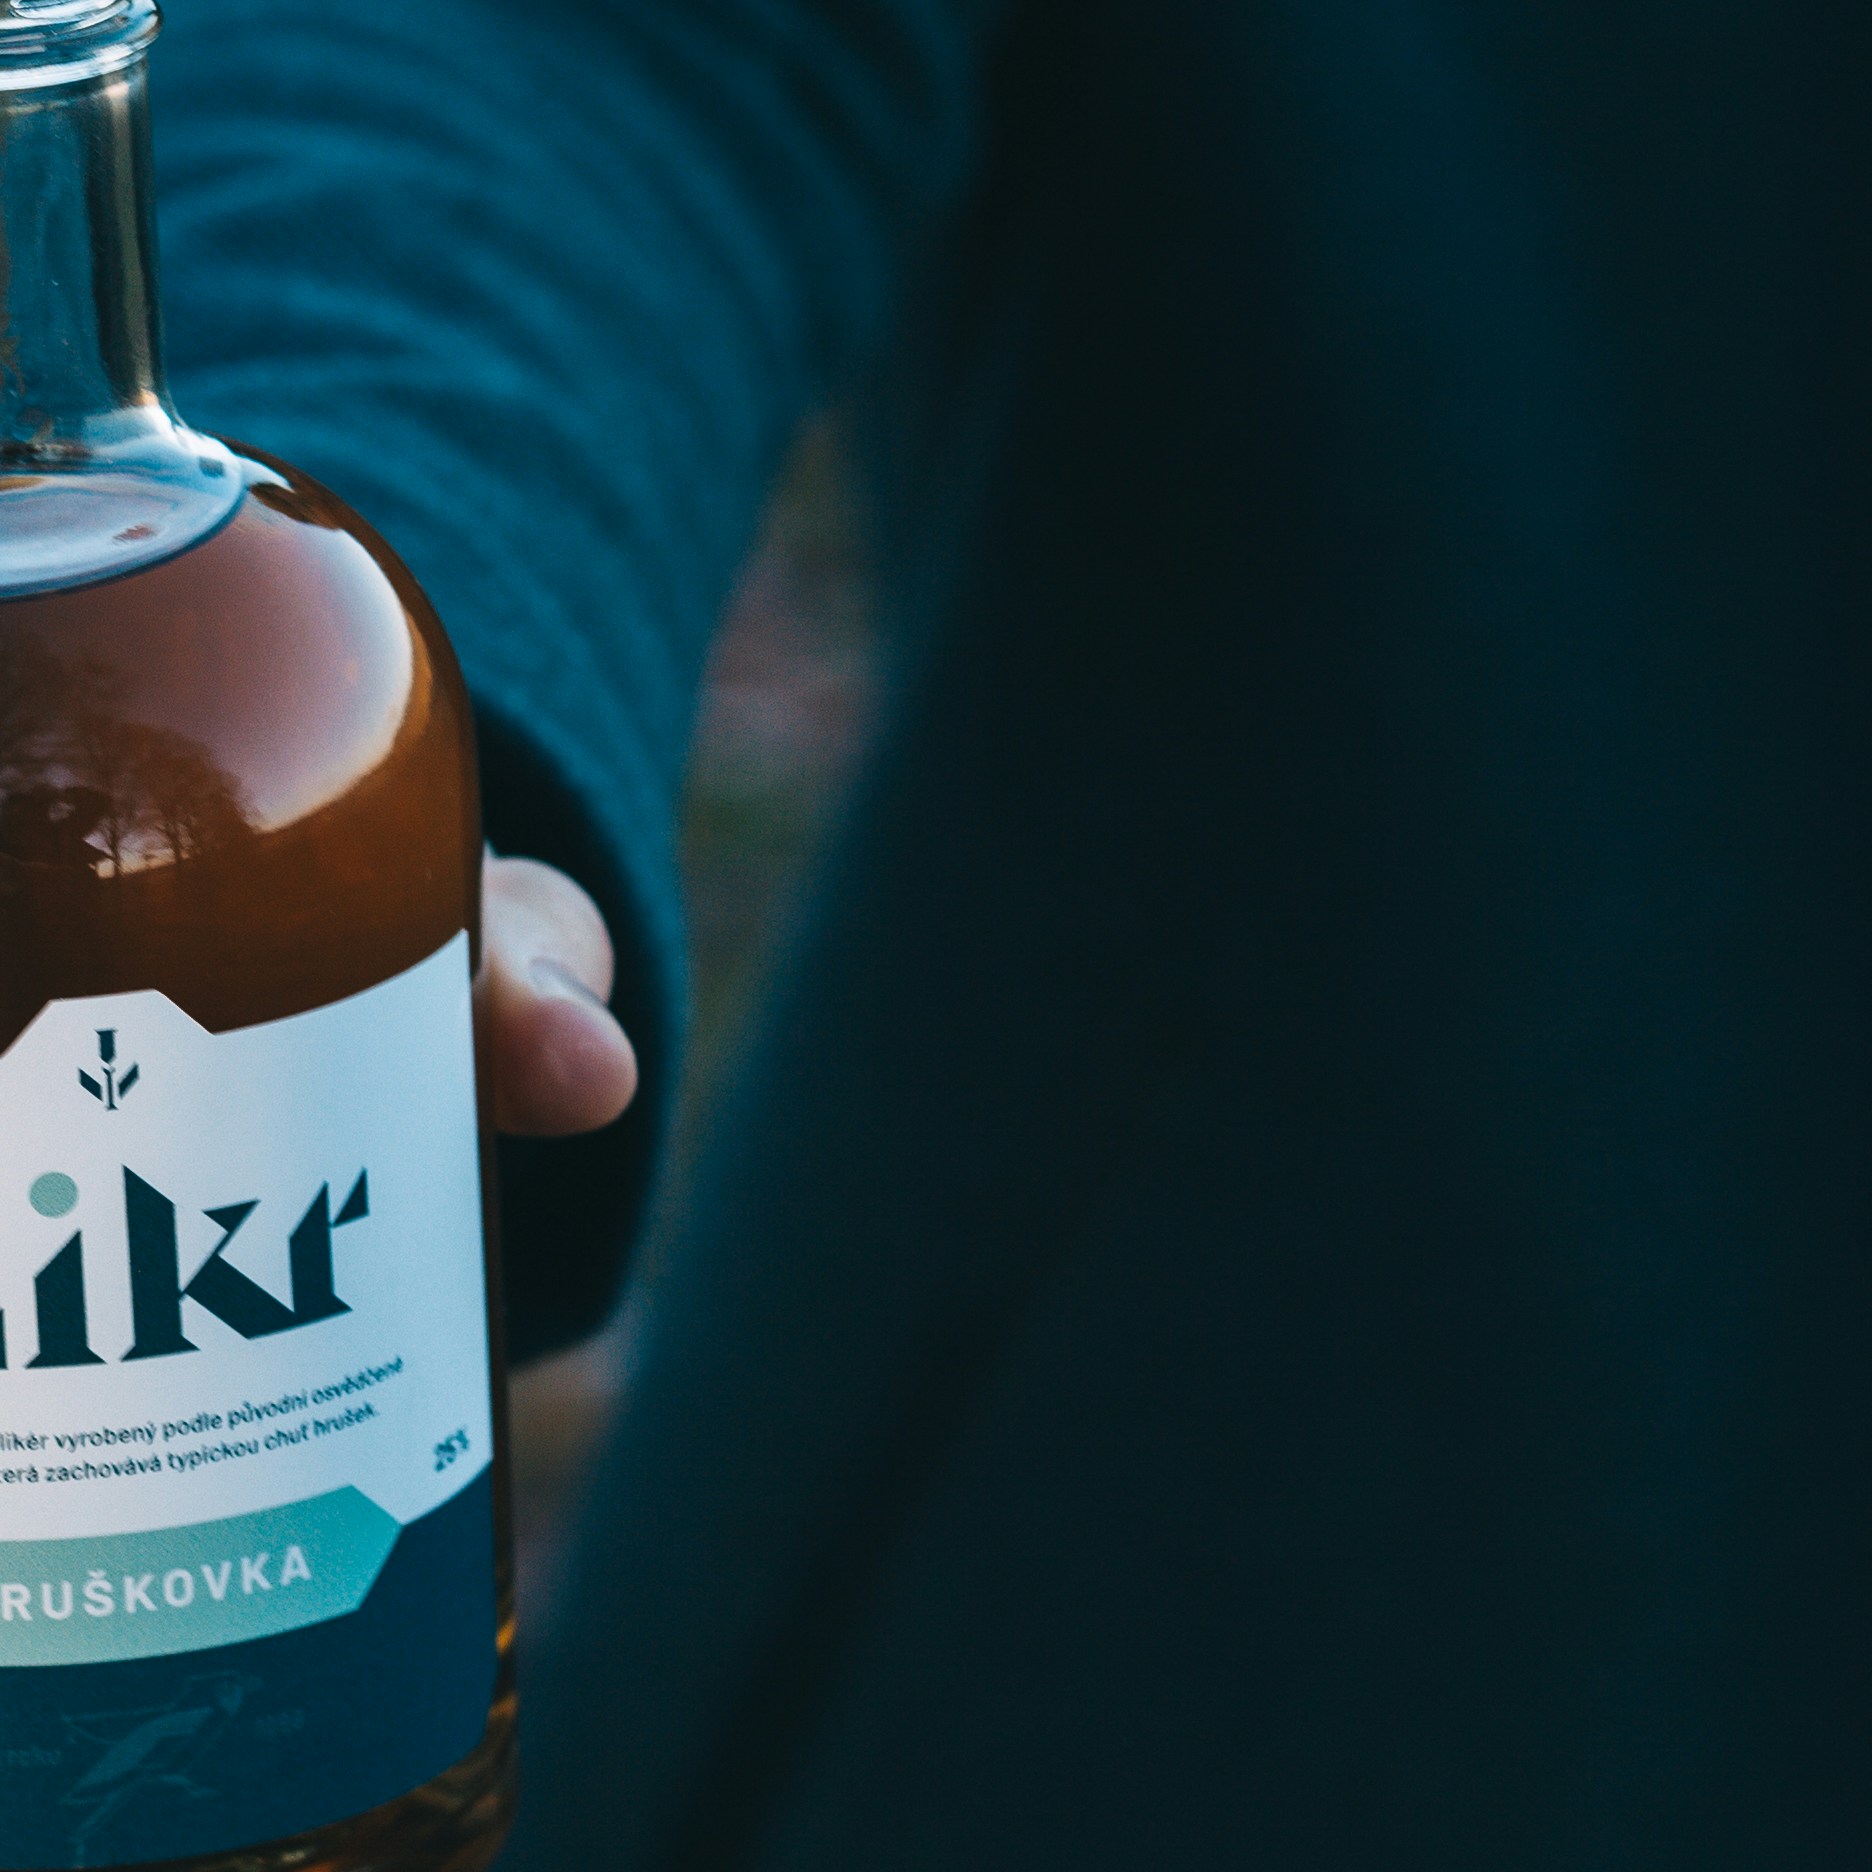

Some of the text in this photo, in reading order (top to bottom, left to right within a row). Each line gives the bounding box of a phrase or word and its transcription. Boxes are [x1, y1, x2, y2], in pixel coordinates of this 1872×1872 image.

[0, 1430, 50, 1451] likér
[54, 1420, 158, 1453] vyrobený
[162, 1411, 223, 1442] podle
[227, 1389, 309, 1430] původní
[44, 1453, 162, 1483] zachovává
[166, 1436, 259, 1473] typickou
[264, 1422, 311, 1452] chuť
